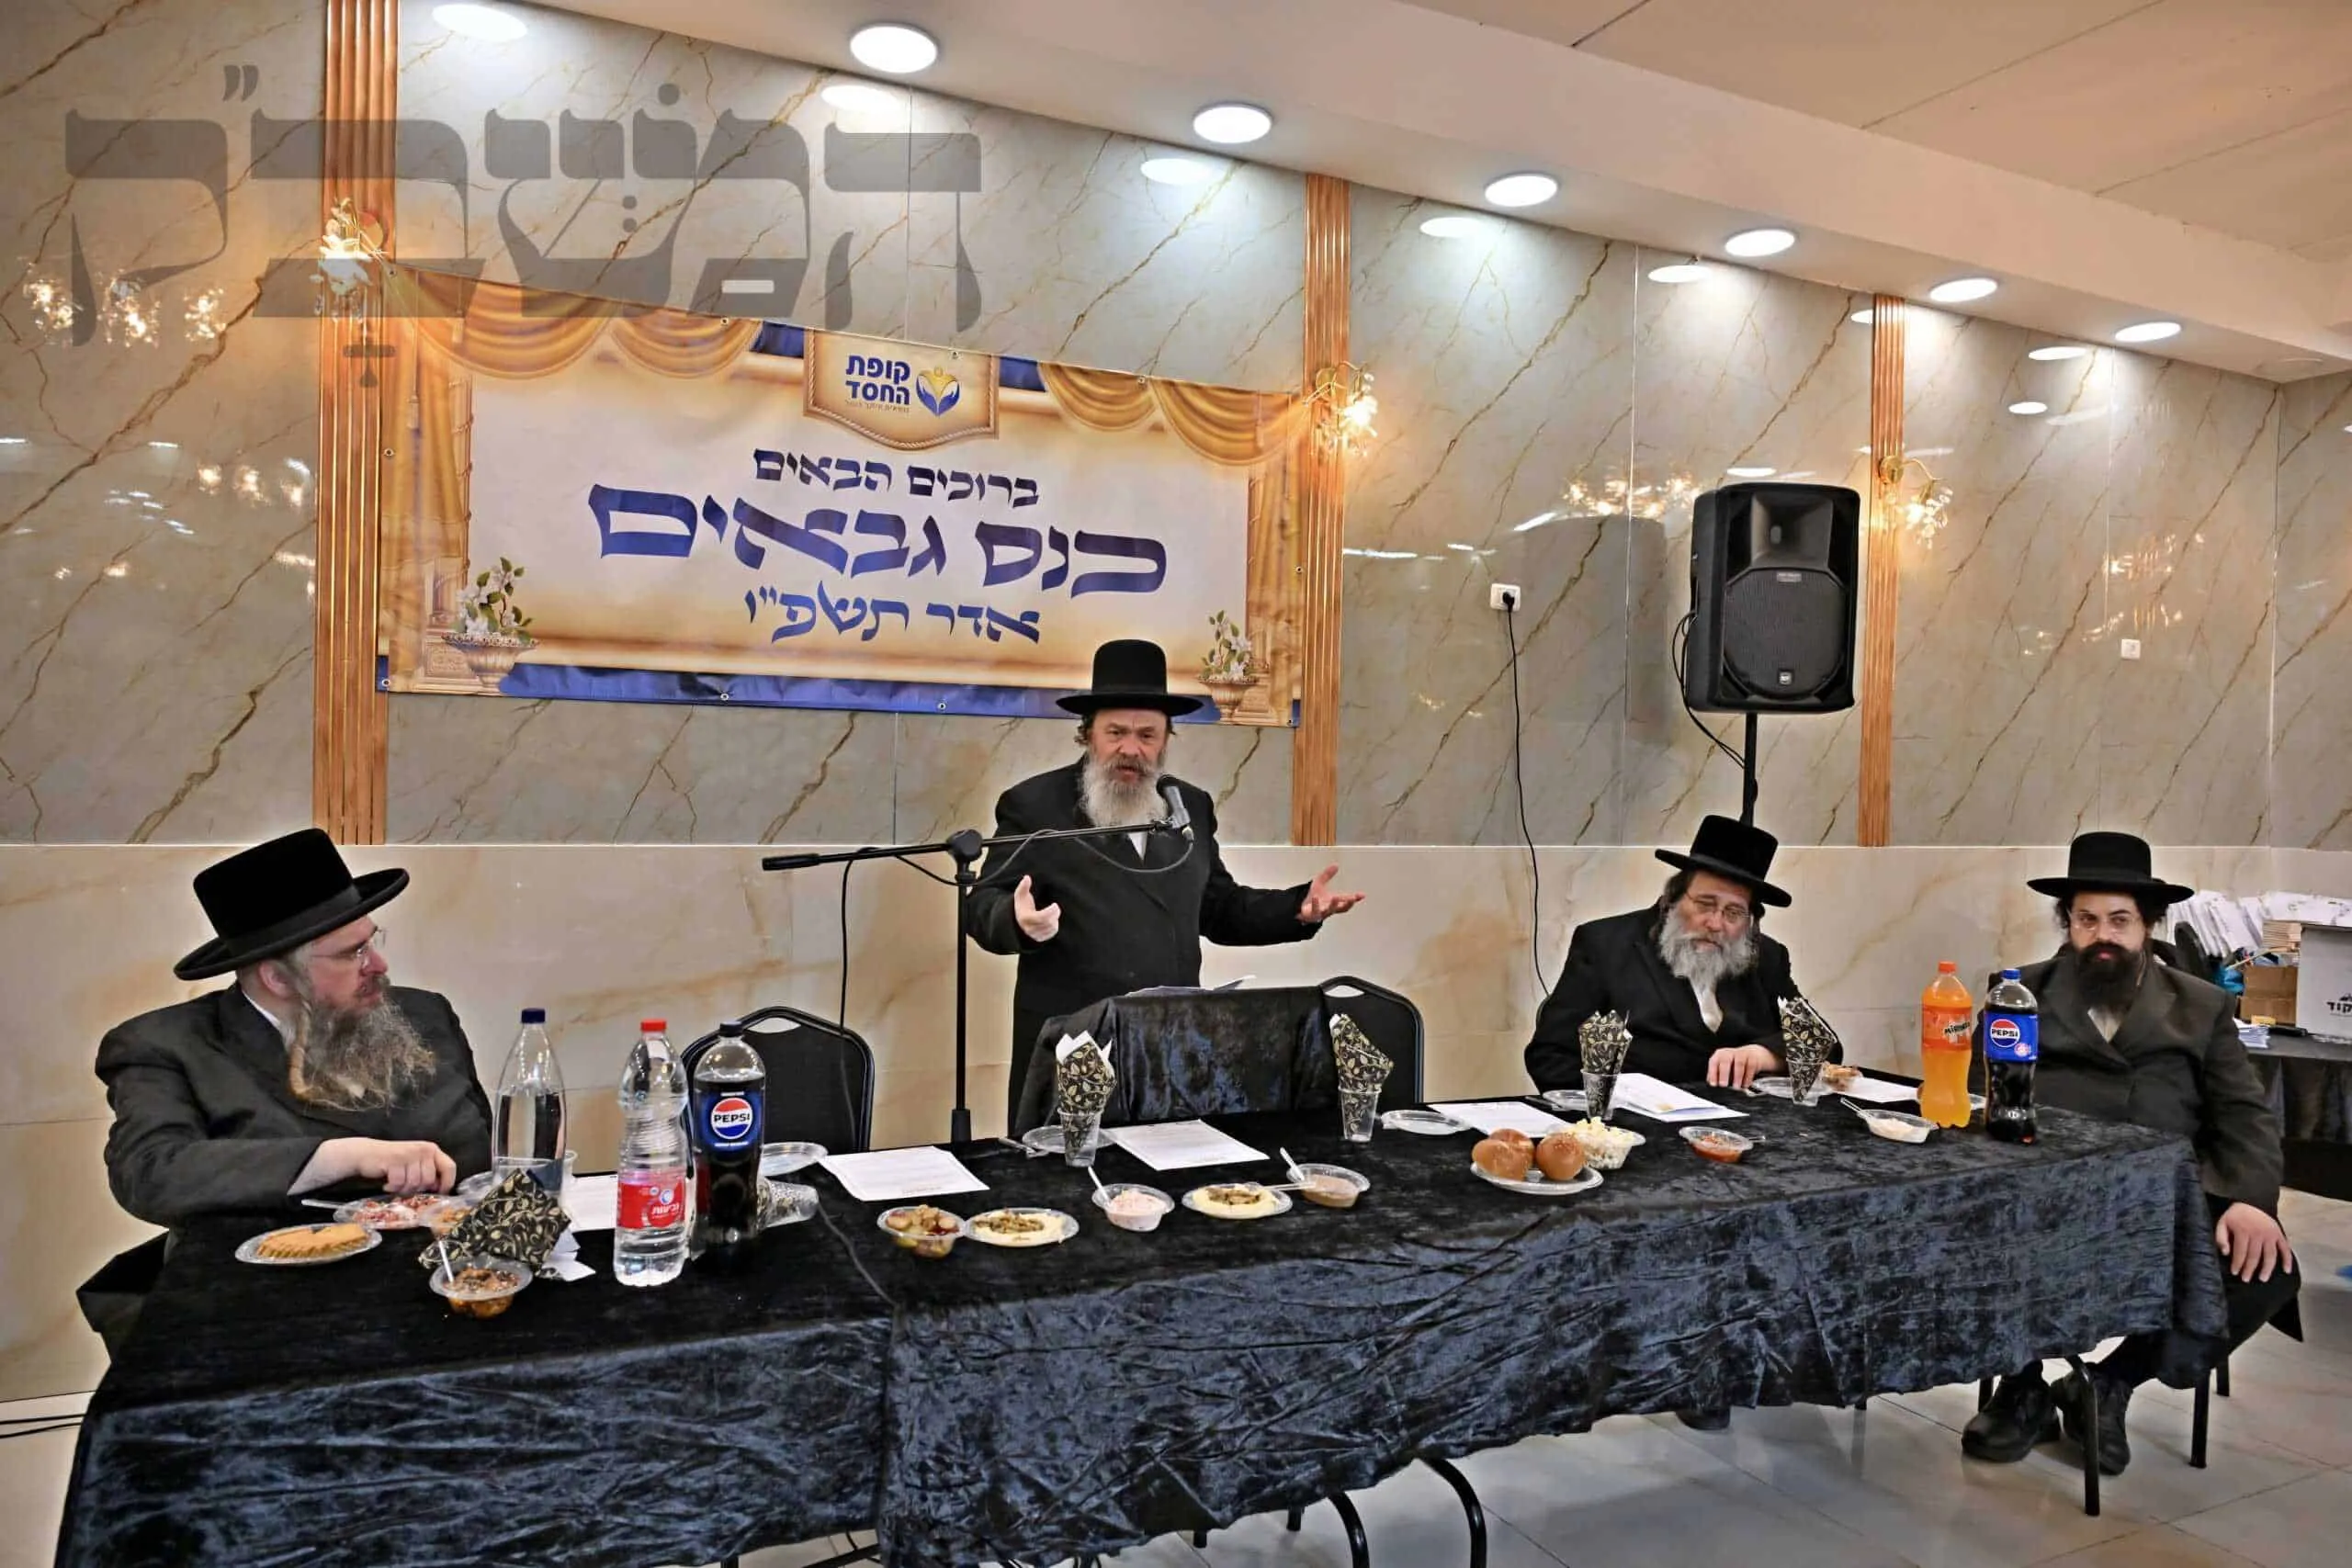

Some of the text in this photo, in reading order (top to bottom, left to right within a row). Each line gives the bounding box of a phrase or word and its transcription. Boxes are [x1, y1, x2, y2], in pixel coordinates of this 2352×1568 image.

[845, 355, 910, 385] קופת
[845, 380, 910, 405] החסד
[753, 448, 1039, 508] ברוכים הבאים
[588, 484, 1167, 598] כנס גבאים
[926, 602, 1040, 644] אדר
[1991, 1028, 2018, 1037] PEPSI
[714, 1113, 750, 1122] PEPSI
